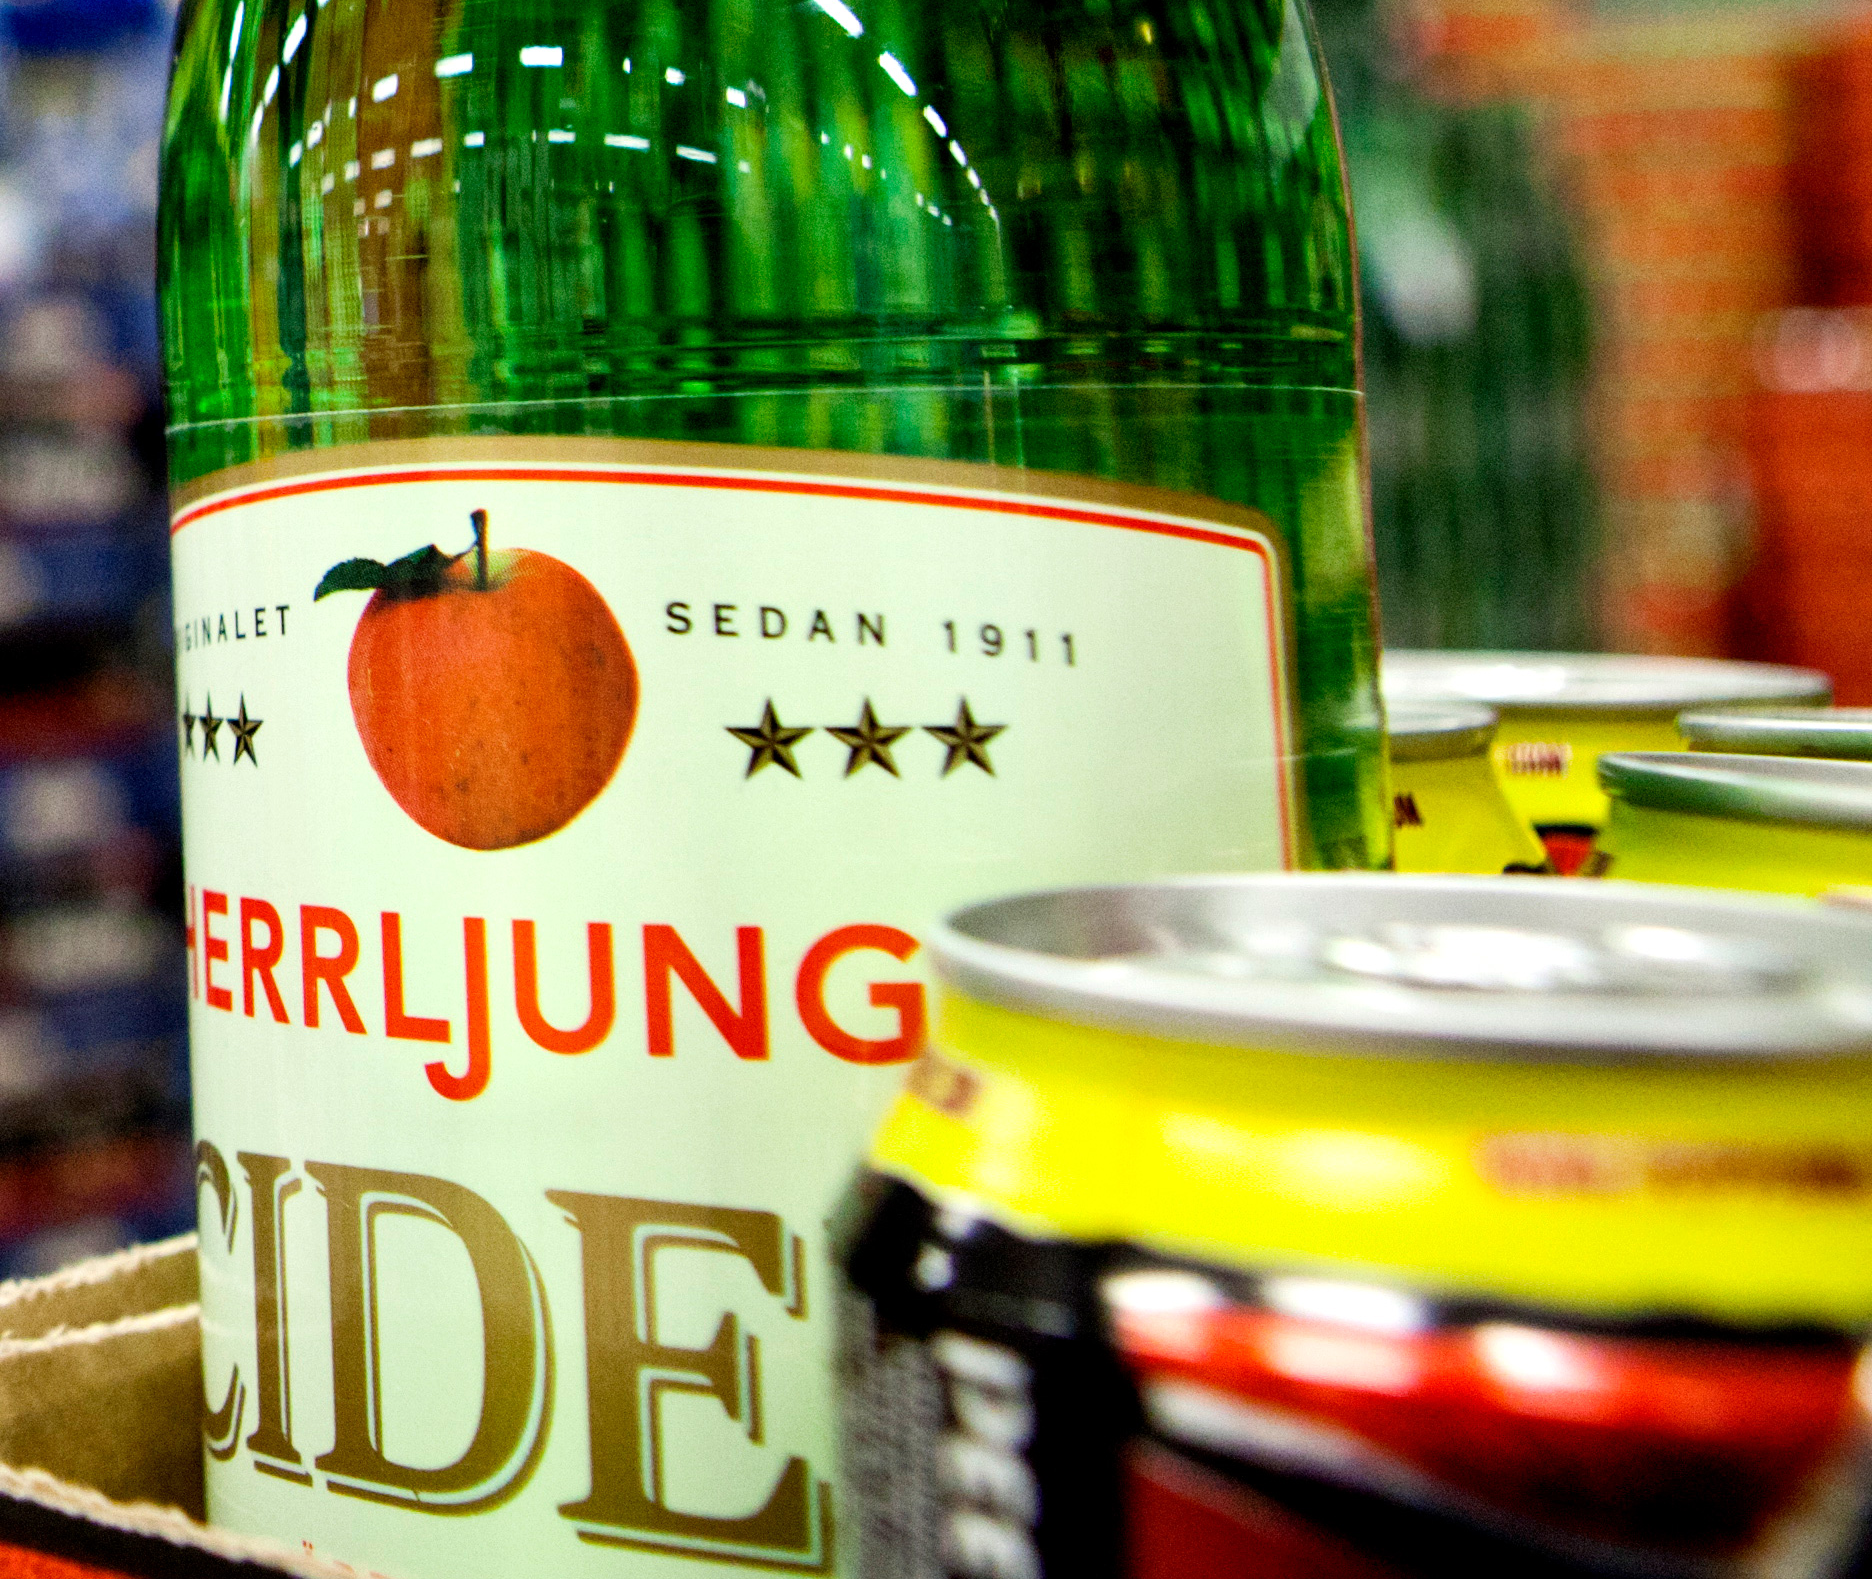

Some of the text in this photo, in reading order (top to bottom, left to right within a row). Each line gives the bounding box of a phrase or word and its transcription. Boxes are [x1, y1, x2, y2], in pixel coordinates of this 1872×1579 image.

[180, 605, 290, 654] GINALET
[665, 601, 1077, 668] SEDAN 1911
[196, 1139, 832, 1577] CIDE
